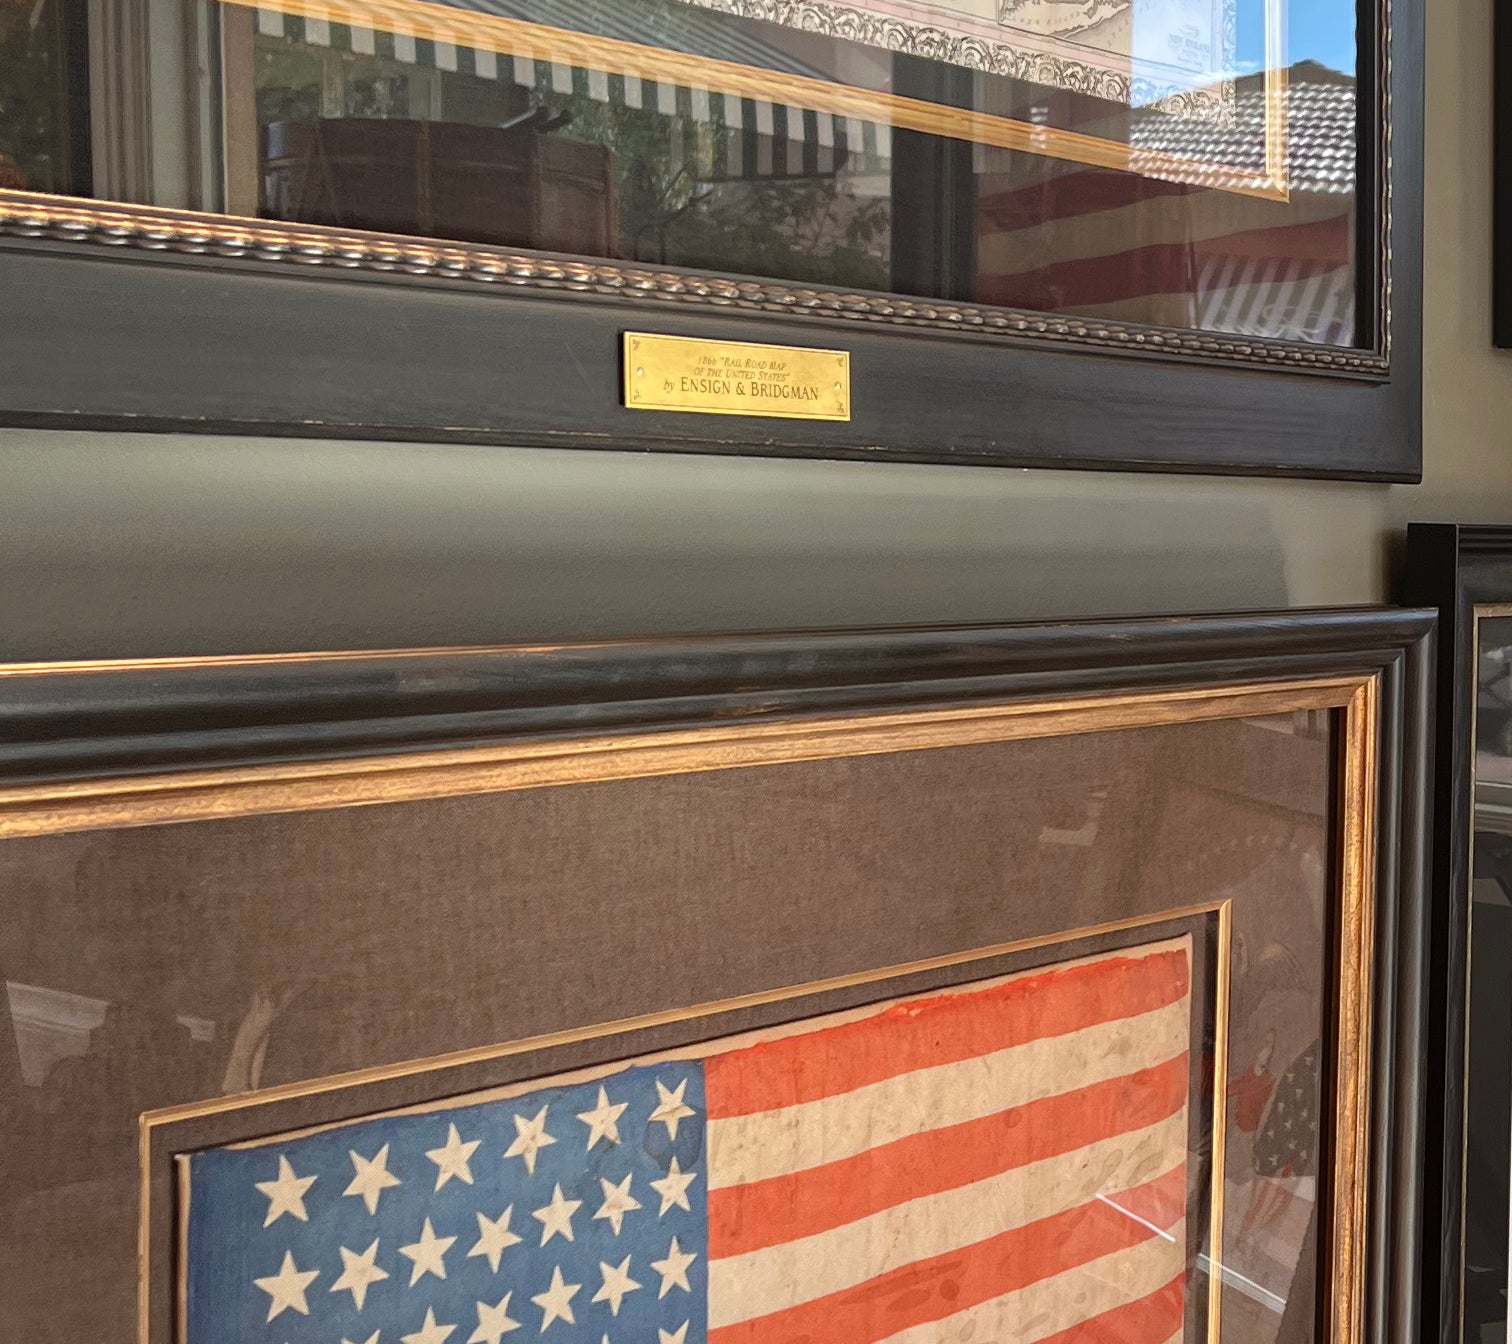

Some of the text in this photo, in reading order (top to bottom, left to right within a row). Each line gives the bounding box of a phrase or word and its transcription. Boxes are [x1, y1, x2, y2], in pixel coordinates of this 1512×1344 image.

[745, 357, 768, 370] ROAD
[769, 360, 787, 372] MAP
[694, 366, 706, 377] OF
[707, 367, 723, 378] THE
[725, 368, 756, 380] UNITED
[663, 376, 819, 401] by ENSIGN & BRIDGMAN
